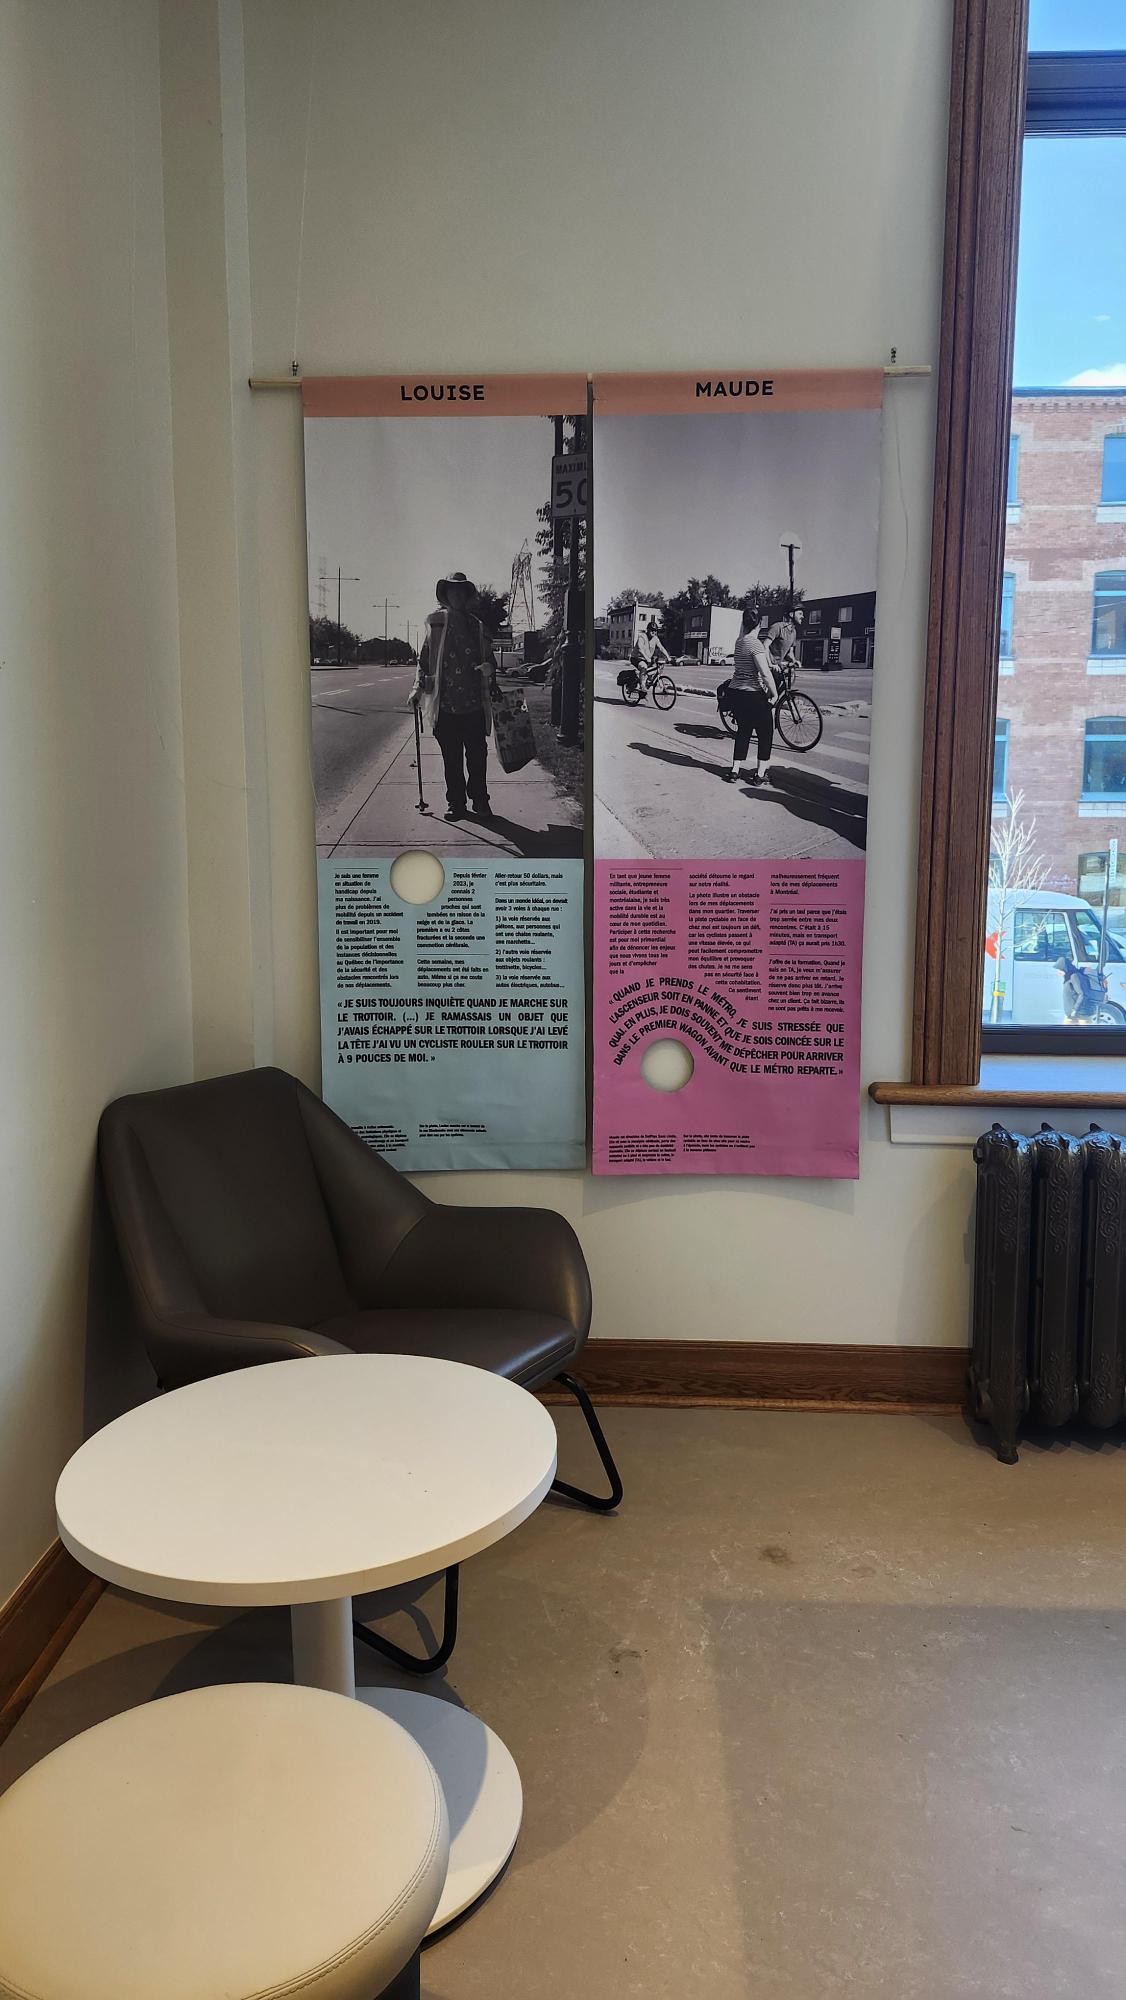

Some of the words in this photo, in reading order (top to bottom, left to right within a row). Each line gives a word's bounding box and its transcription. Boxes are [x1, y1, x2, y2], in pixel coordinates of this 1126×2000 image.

[400, 384, 485, 401] LOUISE
[695, 380, 774, 398] MAUDE
[344, 999, 354, 1008] JE
[356, 999, 377, 1007] SUIS
[378, 999, 423, 1007] TOUJOURS
[426, 997, 464, 1008] INQUIÈTE
[467, 999, 496, 1008] QUAND
[499, 999, 508, 1007] JE
[510, 999, 548, 1007] MARCHE
[550, 999, 568, 1007] SUR
[613, 982, 641, 1001] QUAND
[645, 978, 654, 988] JE
[659, 978, 694, 989] PRENDS
[698, 985, 709, 996] LE
[711, 992, 737, 1018] MÉTRO,
[736, 1018, 748, 1028] JE
[752, 1022, 772, 1030] SUIS
[778, 1021, 821, 1031] STRESSÉE
[826, 1024, 844, 1032] QUE
[338, 1013, 348, 1022] LE
[353, 1012, 396, 1021] TROTTOIR.
[403, 1012, 418, 1022] (...)
[425, 1012, 434, 1021] JE
[442, 1012, 491, 1021] RAMASSAIS
[499, 1012, 511, 1021] UN
[518, 1012, 544, 1021] OBJET
[550, 1013, 568, 1022] QUE
[609, 992, 659, 1024] L'ASCENSEUR
[661, 991, 680, 1000] SOIT
[681, 994, 694, 1004] EN
[694, 999, 720, 1020] PANNE
[716, 1017, 728, 1028] ET
[724, 1027, 742, 1041] QUE
[743, 1035, 751, 1044] JE
[753, 1036, 773, 1045] SOIS
[775, 1035, 812, 1046] COINCÉE
[814, 1038, 831, 1046] SUR
[834, 1038, 844, 1047] LE
[338, 1027, 369, 1036] J'AVAIS
[372, 1024, 412, 1035] ÉCHAPPÉ
[415, 1026, 432, 1034] SUR
[435, 1026, 445, 1034] LE
[447, 1026, 485, 1034] TROTTOIR
[488, 1026, 528, 1036] LORSQUE
[530, 1026, 545, 1035] J'AI
[548, 1025, 568, 1035] LEVÉ
[609, 1028, 627, 1048] QUAI.
[624, 1017, 636, 1030] EN
[635, 1008, 658, 1021] PLUS,
[659, 1006, 668, 1014] JE
[670, 1006, 690, 1017] DOIS
[691, 1013, 722, 1042] SOUVENT
[720, 1041, 734, 1053] ME
[734, 1047, 778, 1059] DÉPÊCHER
[781, 1051, 804, 1060] POUR
[806, 1052, 843, 1061] ARRIVER
[338, 1041, 349, 1049] LA
[350, 1038, 370, 1049] TÊTE
[372, 1040, 387, 1048] J'AI
[389, 1040, 401, 1048] VU
[404, 1040, 416, 1048] UN
[419, 1040, 458, 1048] CYCLISTE
[461, 1040, 494, 1048] ROULER
[497, 1040, 515, 1048] SUR
[517, 1040, 527, 1048] LE
[529, 1041, 568, 1049] TROTTOIR
[614, 1043, 631, 1066] DANS
[629, 1033, 640, 1044] LE
[639, 1020, 677, 1036] PREMIER
[680, 1022, 708, 1046] WAGON
[704, 1046, 729, 1066] AVANT
[730, 1061, 748, 1073] QUE
[751, 1065, 760, 1073] LE
[764, 1063, 794, 1074] MÉTRO
[797, 1066, 837, 1075] REPARTE.
[338, 1053, 344, 1063] À
[347, 1055, 352, 1063] 9
[356, 1054, 391, 1063] POUCES
[394, 1054, 406, 1063] DE
[409, 1054, 428, 1063] MOI.
